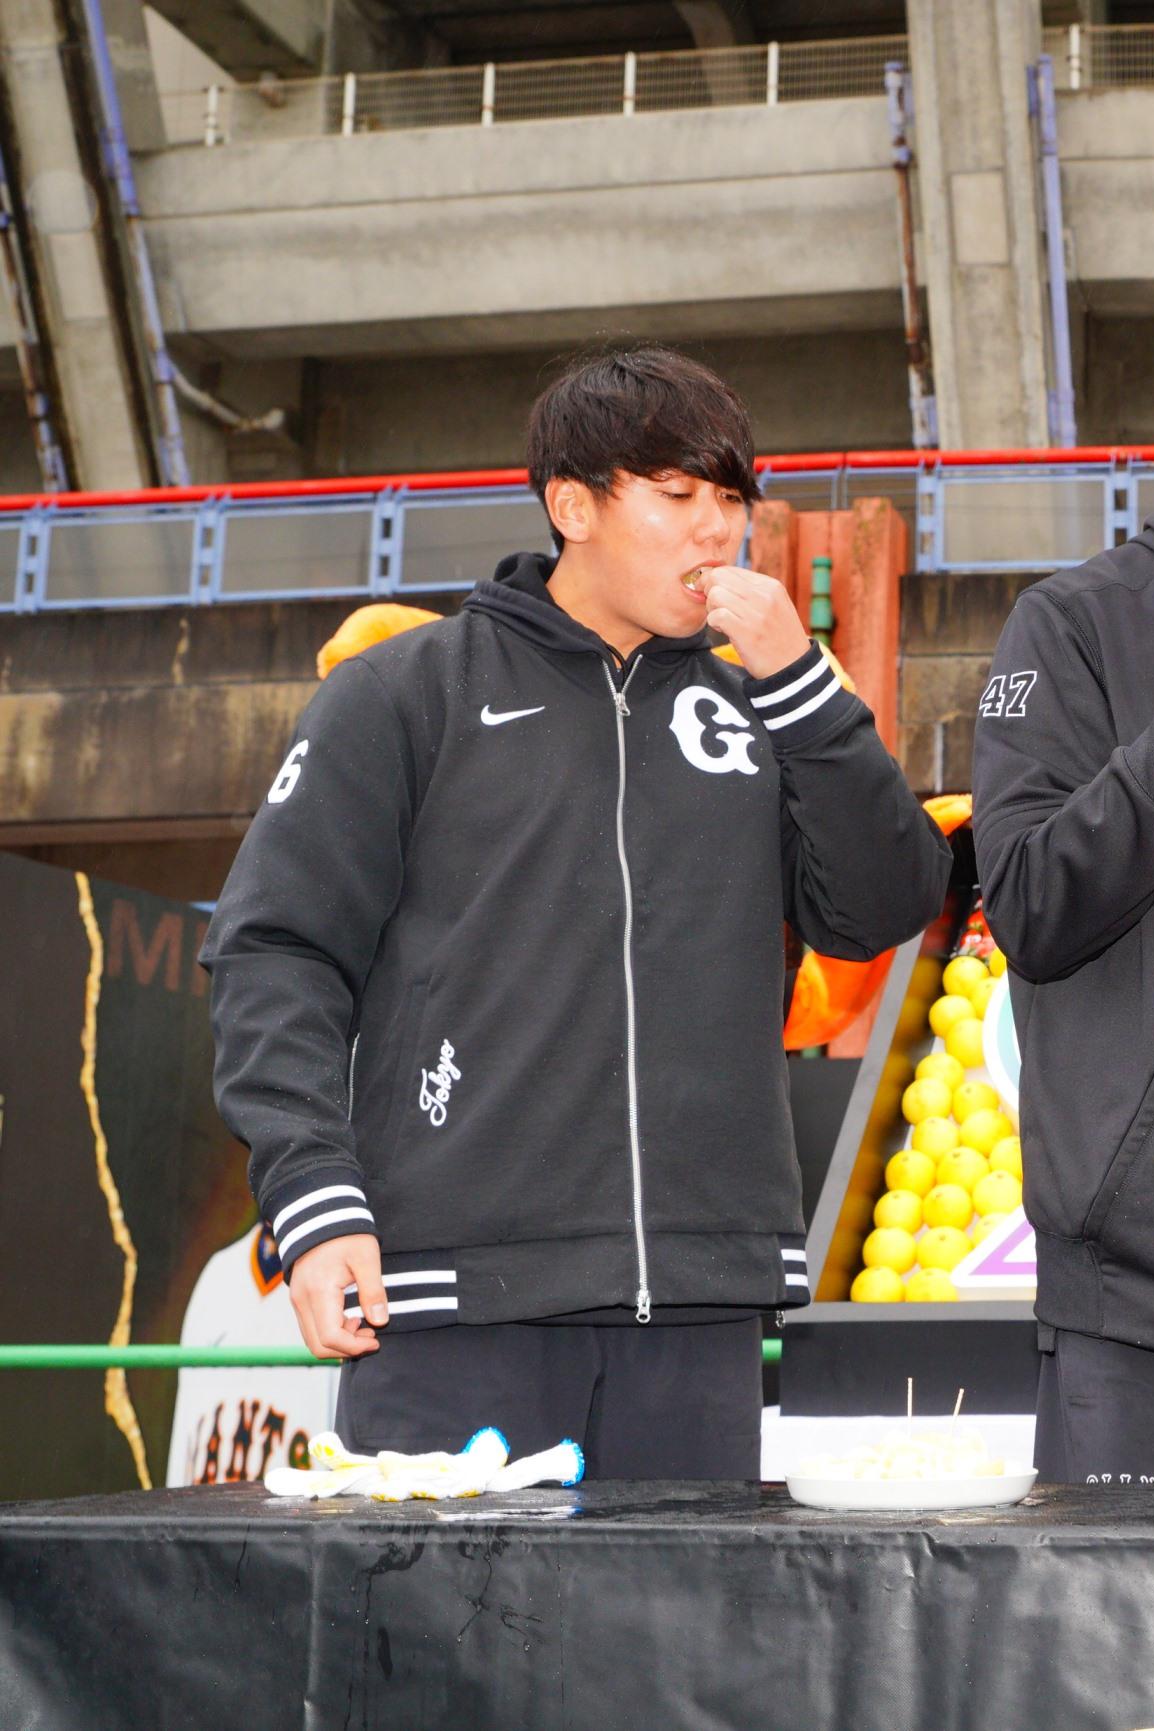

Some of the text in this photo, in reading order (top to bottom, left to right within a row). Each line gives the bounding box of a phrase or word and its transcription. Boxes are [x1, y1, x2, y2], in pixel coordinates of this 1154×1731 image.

[668, 685, 760, 775] G
[979, 670, 1038, 718] 47
[267, 739, 309, 804] 6
[420, 1039, 461, 1127] Tokyo
